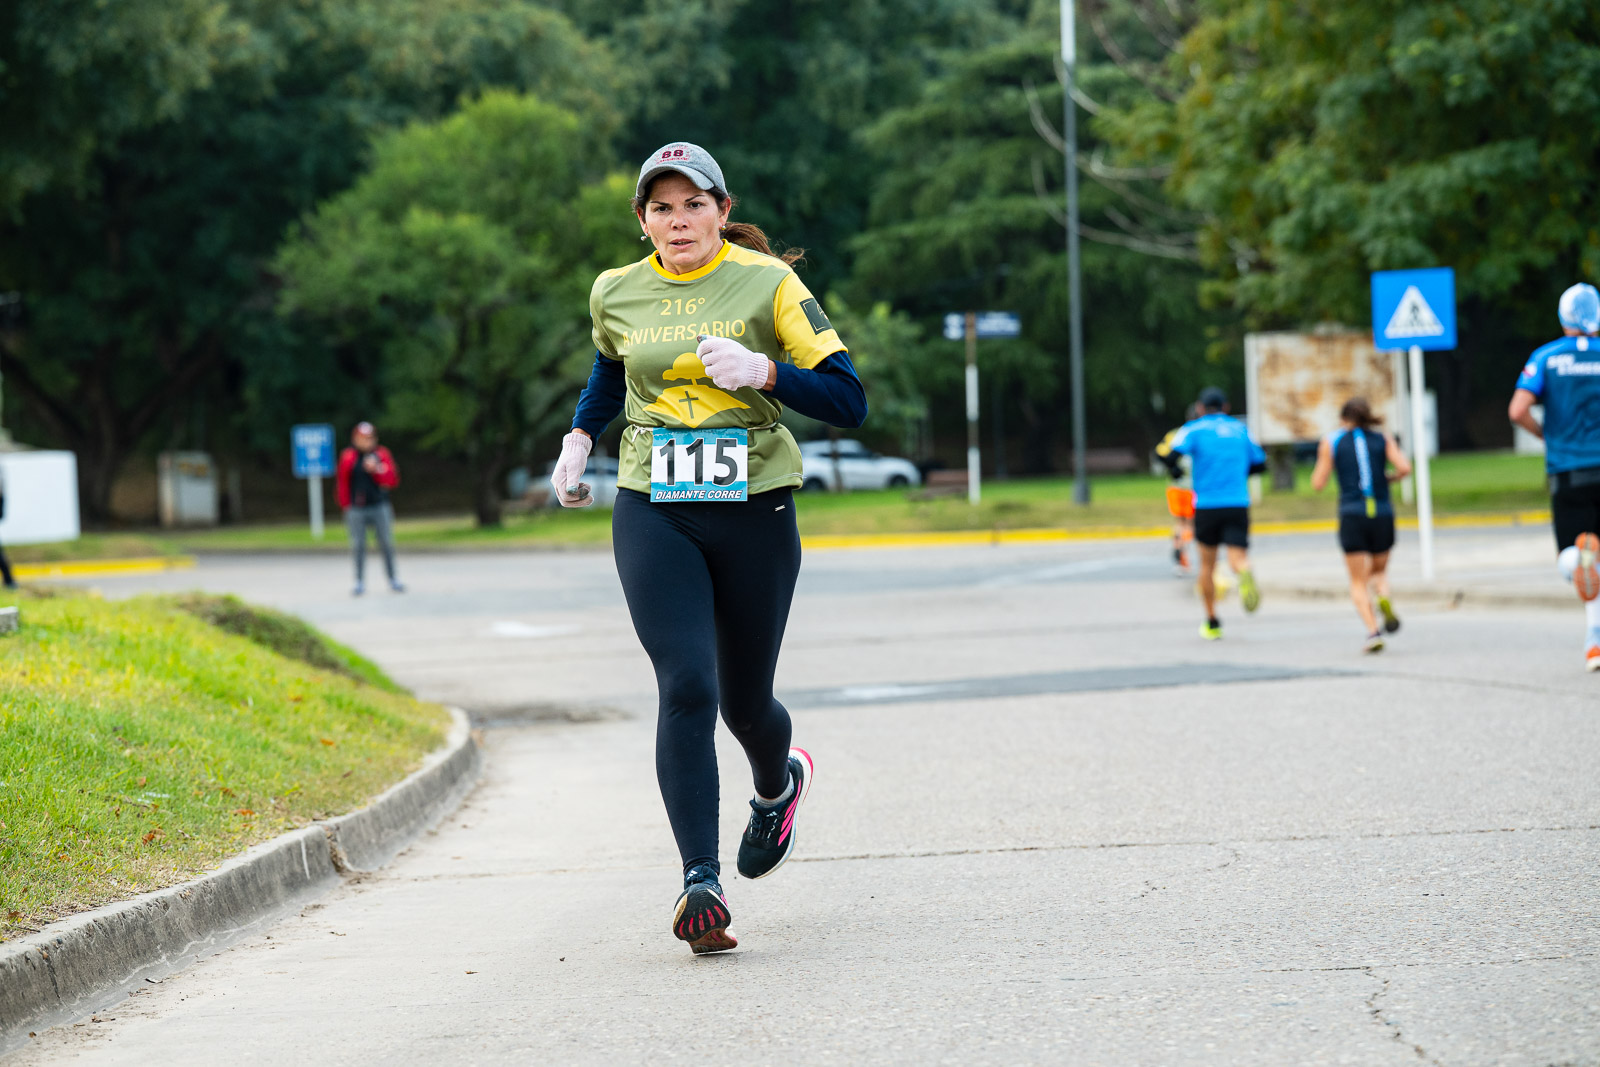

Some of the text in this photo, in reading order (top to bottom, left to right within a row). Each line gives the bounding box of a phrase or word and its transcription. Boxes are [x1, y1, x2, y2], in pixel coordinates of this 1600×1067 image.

[661, 149, 684, 159] 88
[622, 319, 746, 348] ANIVERSARIO
[659, 437, 739, 487] 115
[655, 489, 744, 500] DIAMANTE CORRE
